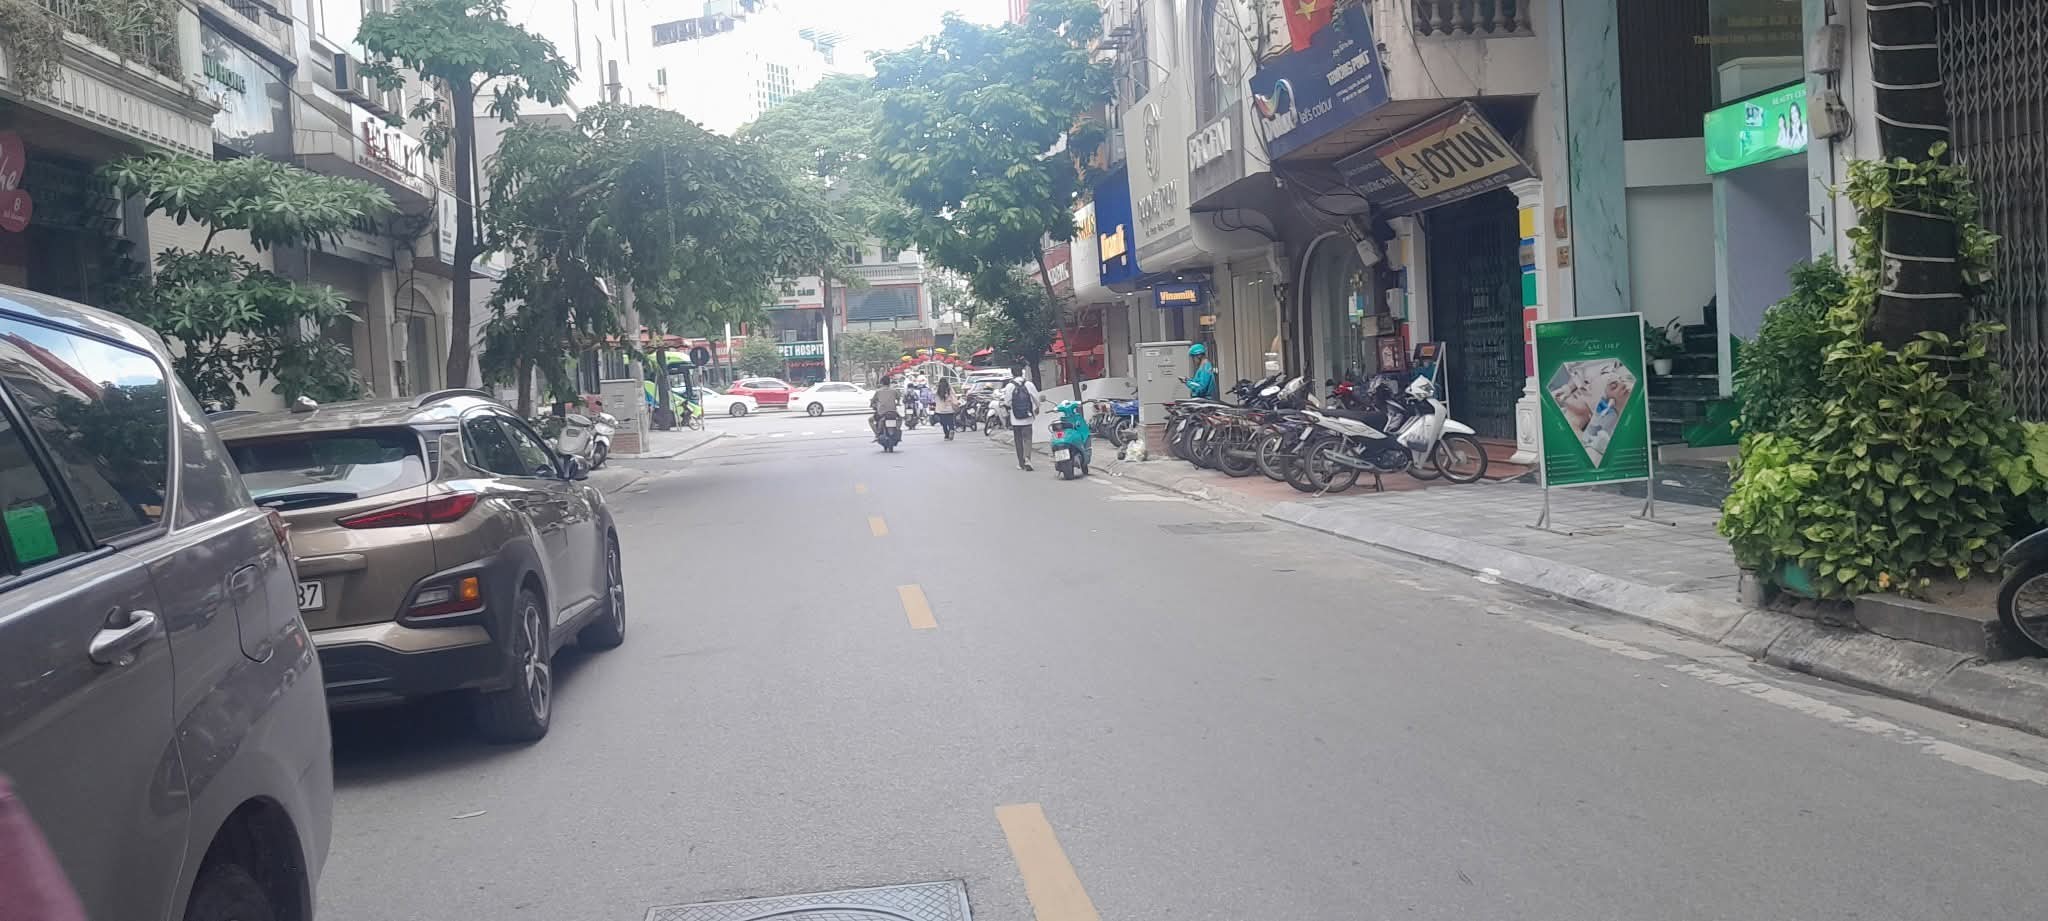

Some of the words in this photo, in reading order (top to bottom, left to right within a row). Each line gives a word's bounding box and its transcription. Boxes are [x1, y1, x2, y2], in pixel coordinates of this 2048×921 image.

[1311, 97, 1332, 118] colour
[1411, 126, 1505, 185] JOTUN
[1160, 289, 1196, 301] Vinamilk
